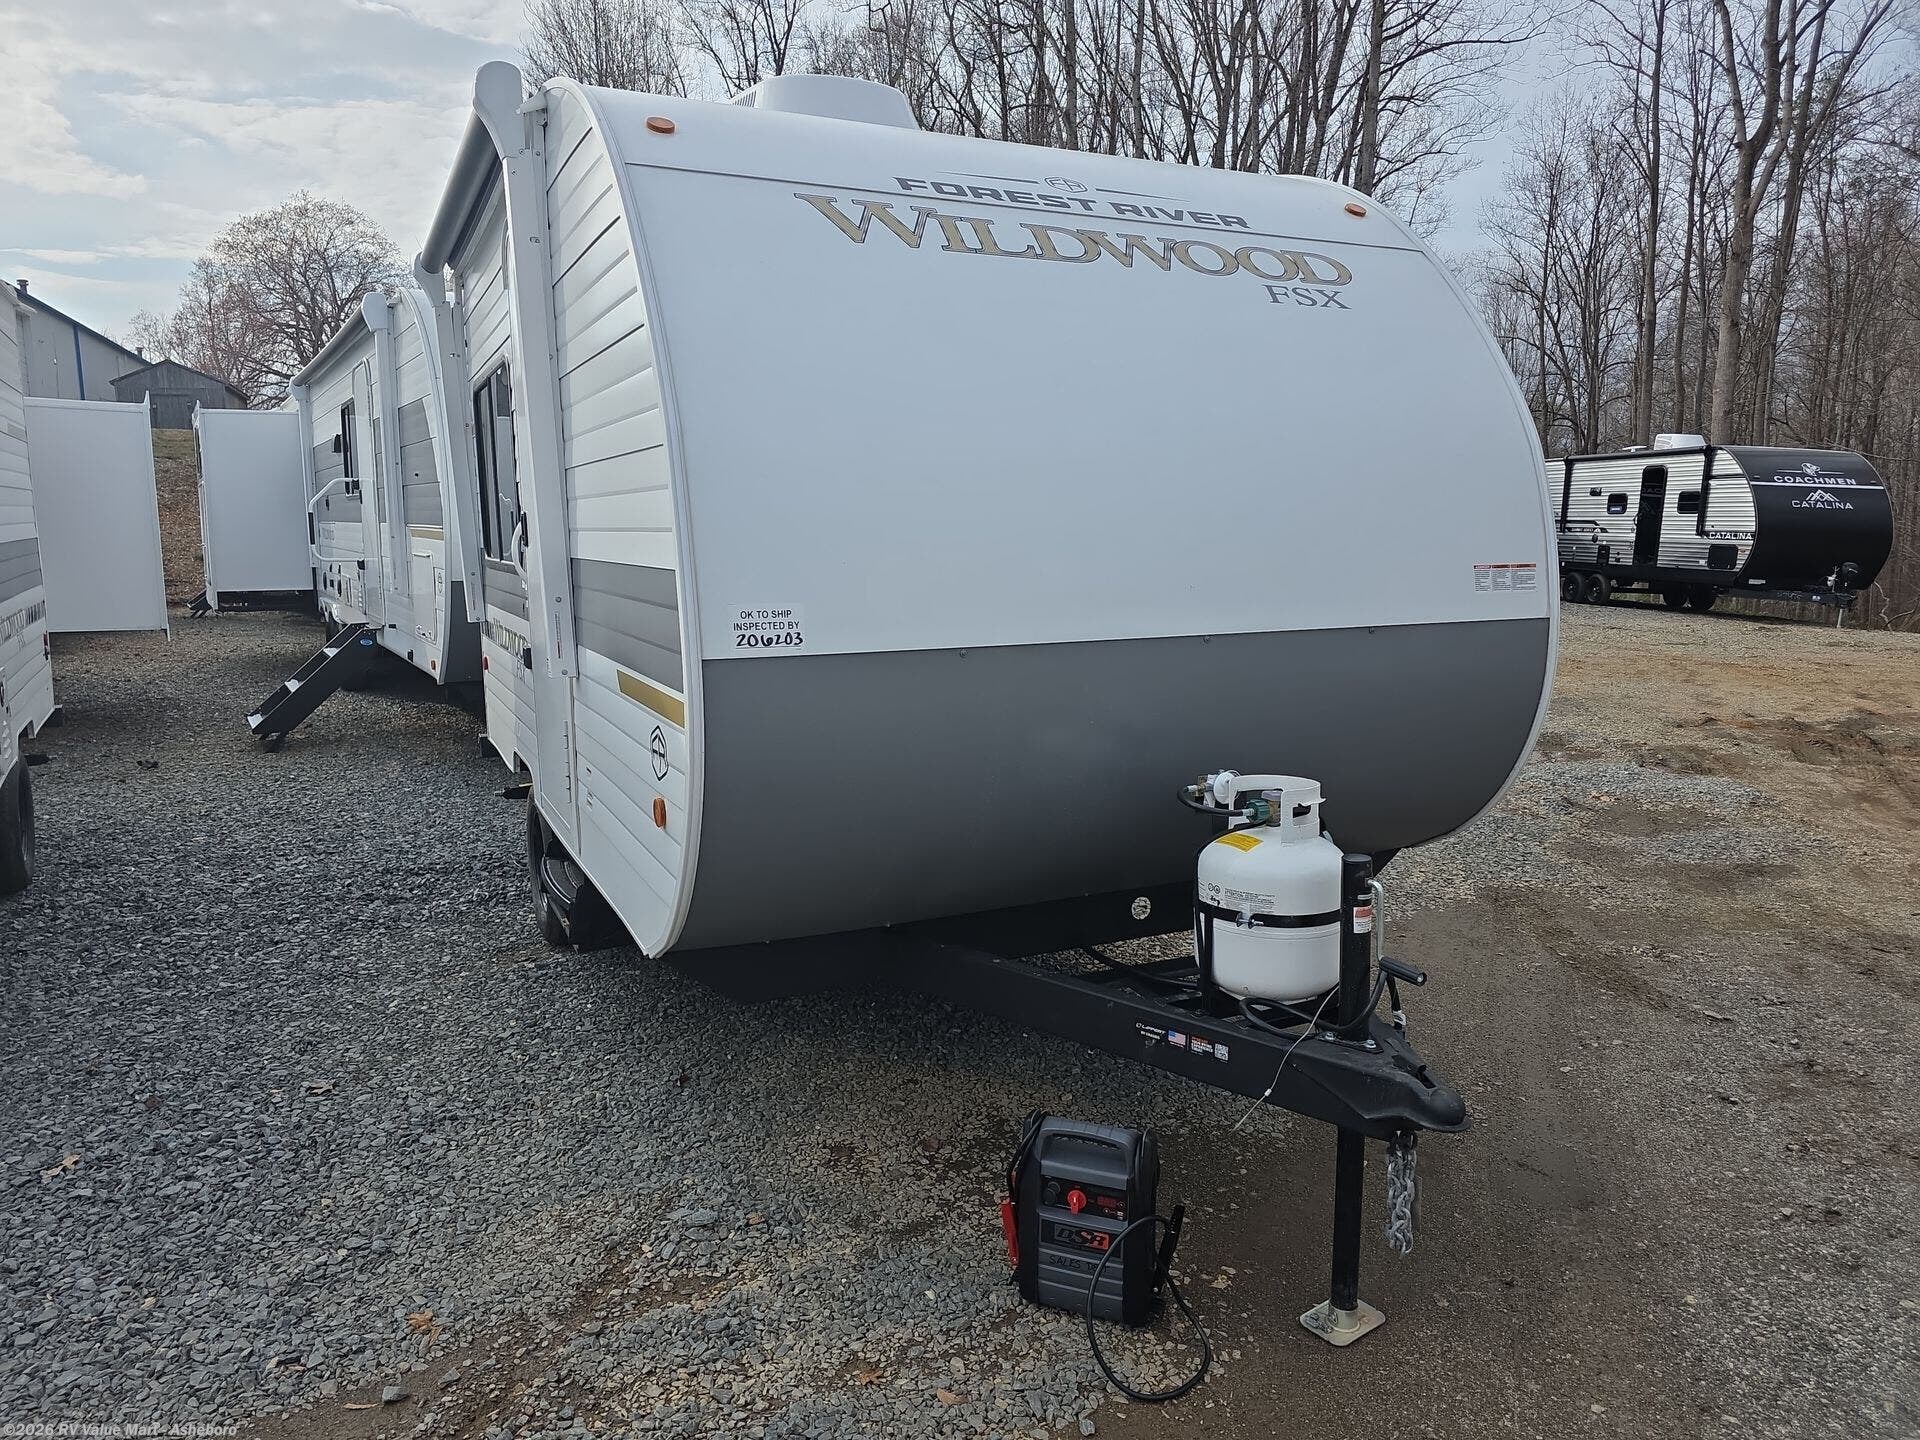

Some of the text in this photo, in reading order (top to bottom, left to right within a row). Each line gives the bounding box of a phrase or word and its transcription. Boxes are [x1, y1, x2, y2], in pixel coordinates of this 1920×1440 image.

[892, 176, 1251, 229] FOREST RIVER
[794, 192, 1353, 287] WILDWOOD
[1262, 284, 1353, 310] FSX
[1773, 475, 1857, 485] COACHMEN
[1791, 500, 1854, 510] CATALINA
[1709, 531, 1753, 540] CATALINA
[740, 609, 792, 619] OK TO SHIP
[733, 621, 800, 631] INSPECTED BY
[736, 631, 804, 647] 206203
